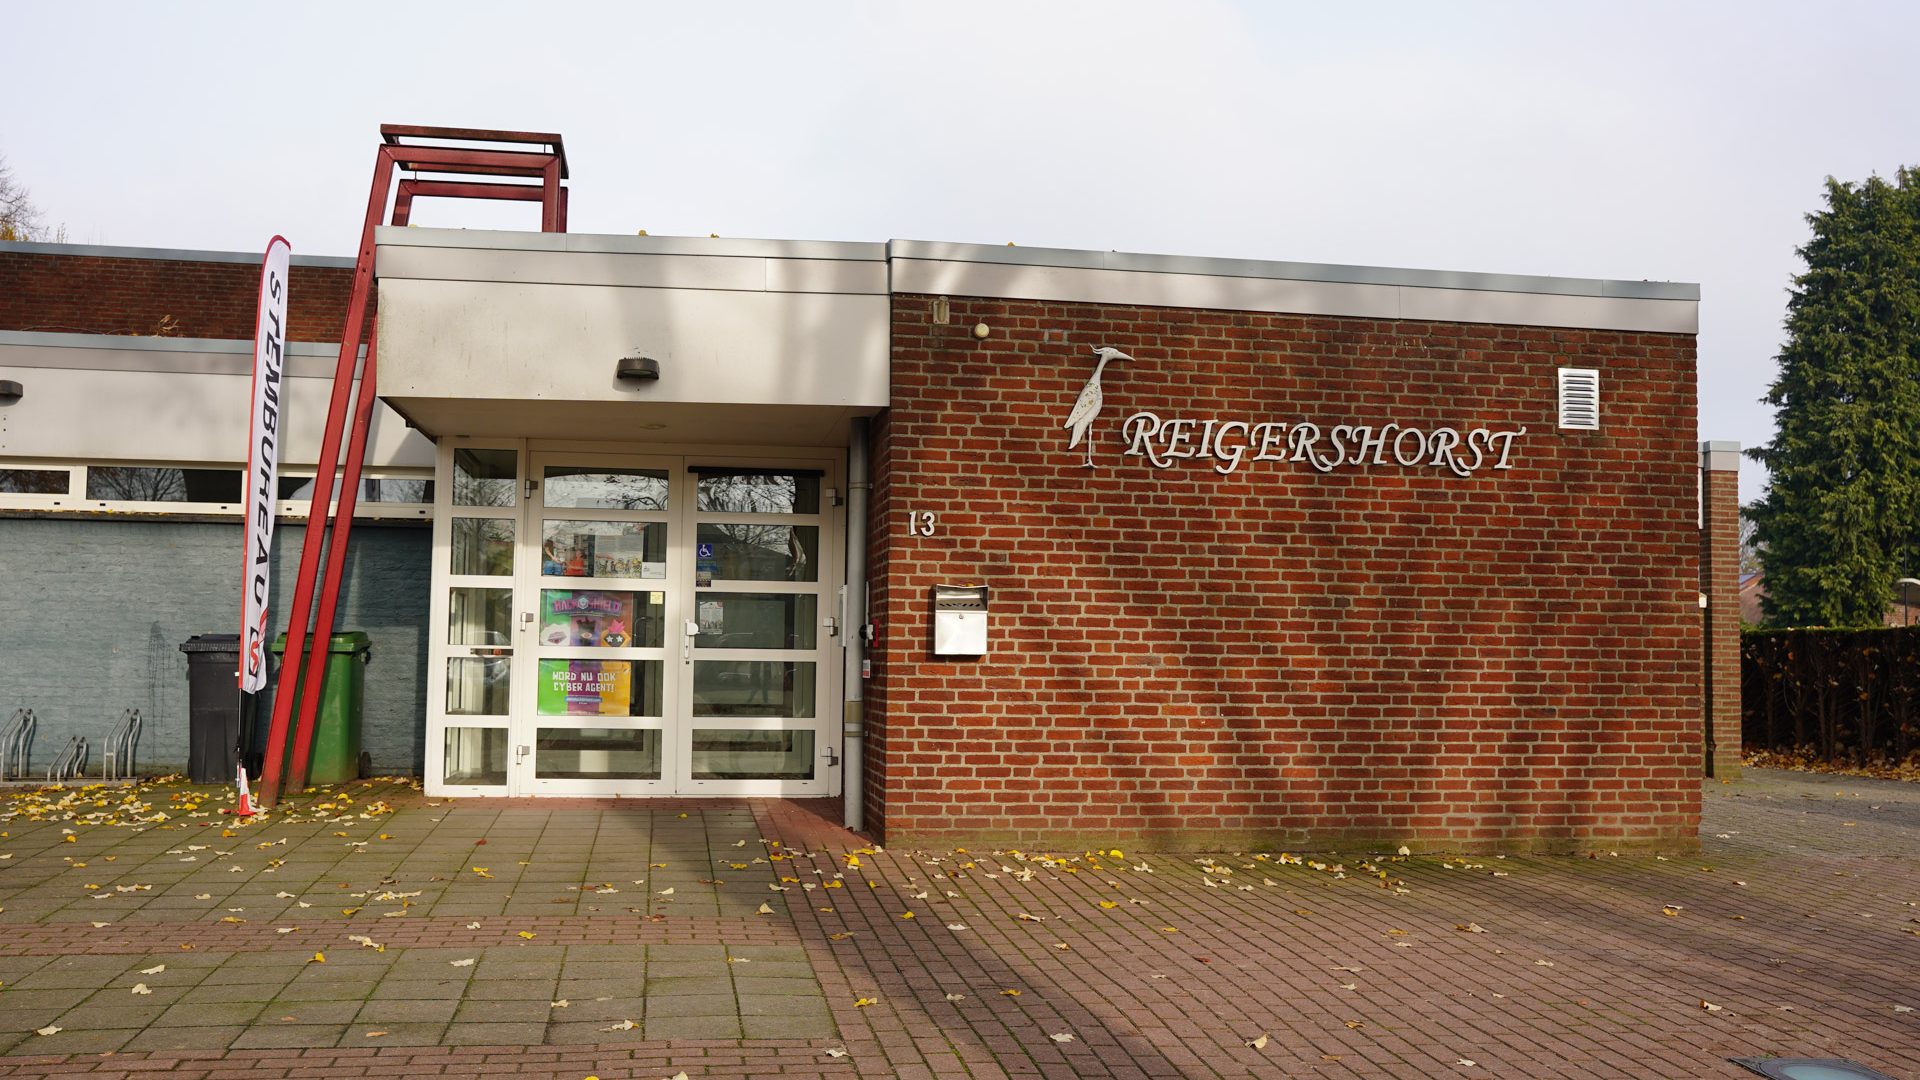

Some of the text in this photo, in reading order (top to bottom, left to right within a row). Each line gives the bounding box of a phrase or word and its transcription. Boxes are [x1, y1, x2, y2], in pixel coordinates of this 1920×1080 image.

[253, 271, 281, 608] STEMBUREAU
[1122, 411, 1527, 477] REIGERSHORST
[908, 510, 936, 538] 13
[552, 671, 616, 682] WORD NU OOK
[553, 682, 583, 692] CYBER
